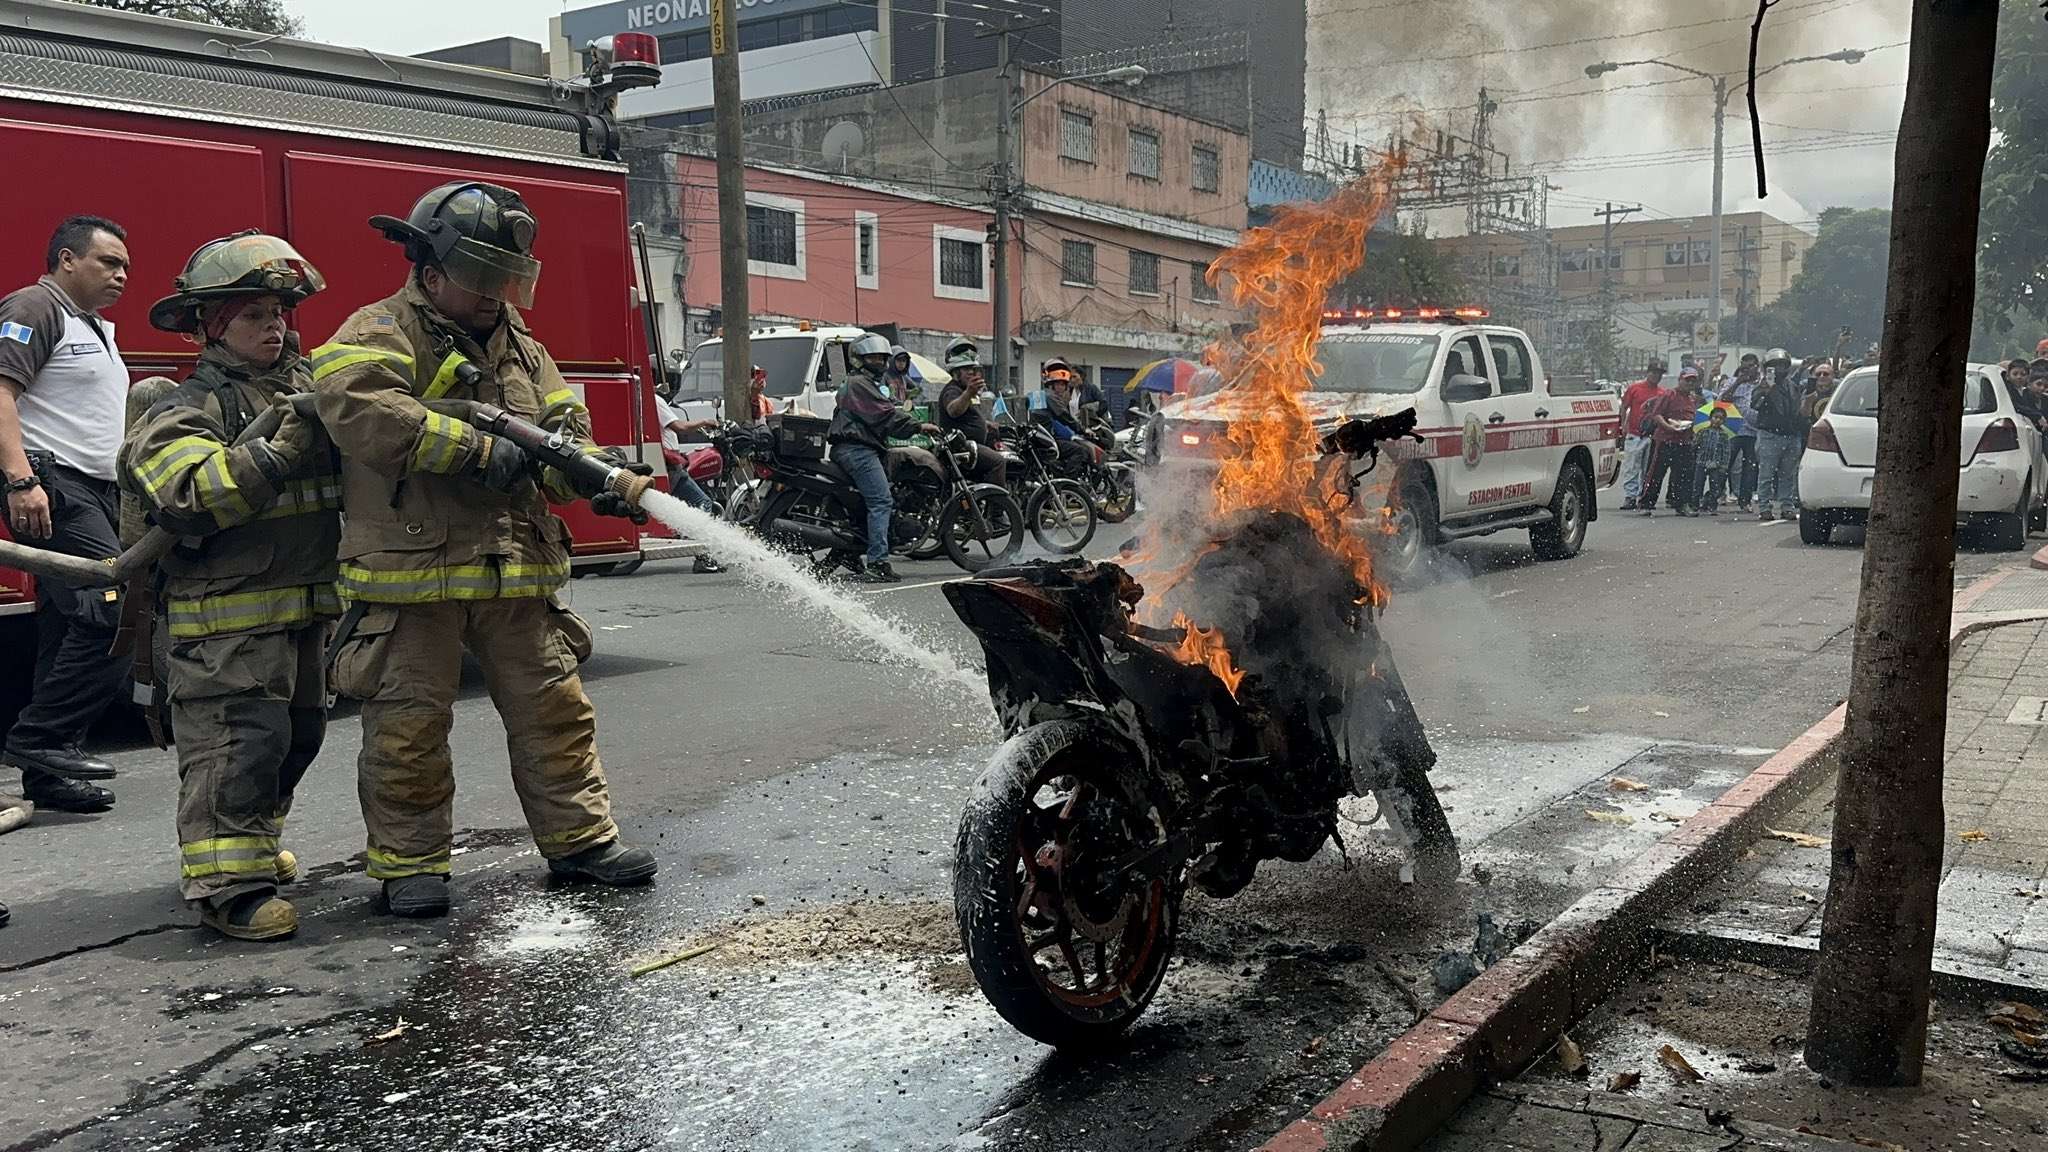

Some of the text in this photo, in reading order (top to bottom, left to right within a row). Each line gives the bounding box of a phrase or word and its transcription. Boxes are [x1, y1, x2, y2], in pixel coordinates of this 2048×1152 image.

[1508, 429, 1548, 450] BOMBEROS
[1468, 481, 1533, 506] ESTACION CENTRAL
